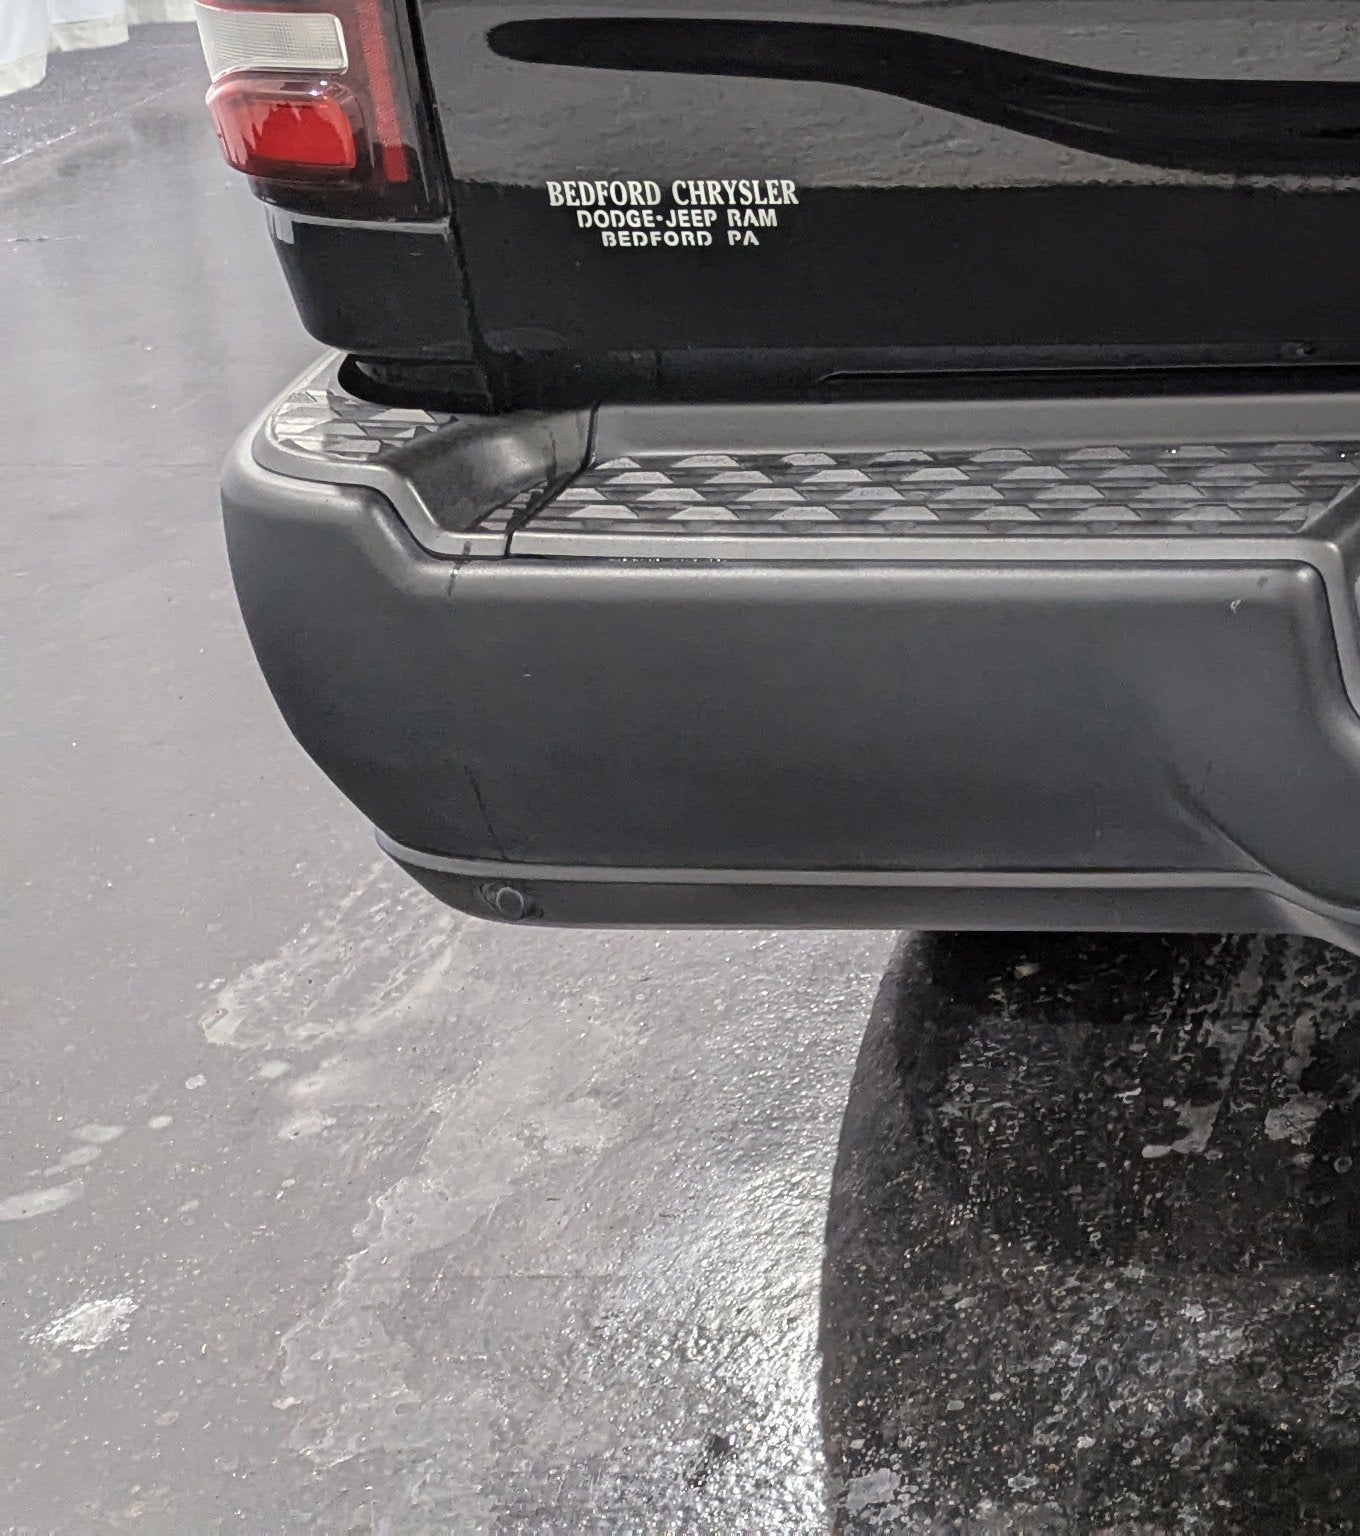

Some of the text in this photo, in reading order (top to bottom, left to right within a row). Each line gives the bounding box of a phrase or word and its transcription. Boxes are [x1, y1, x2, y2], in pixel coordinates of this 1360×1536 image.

[546, 179, 799, 206] BEDFORD CHRYSLER
[727, 209, 778, 227] RAM
[602, 230, 760, 247] BEDFORD PA
